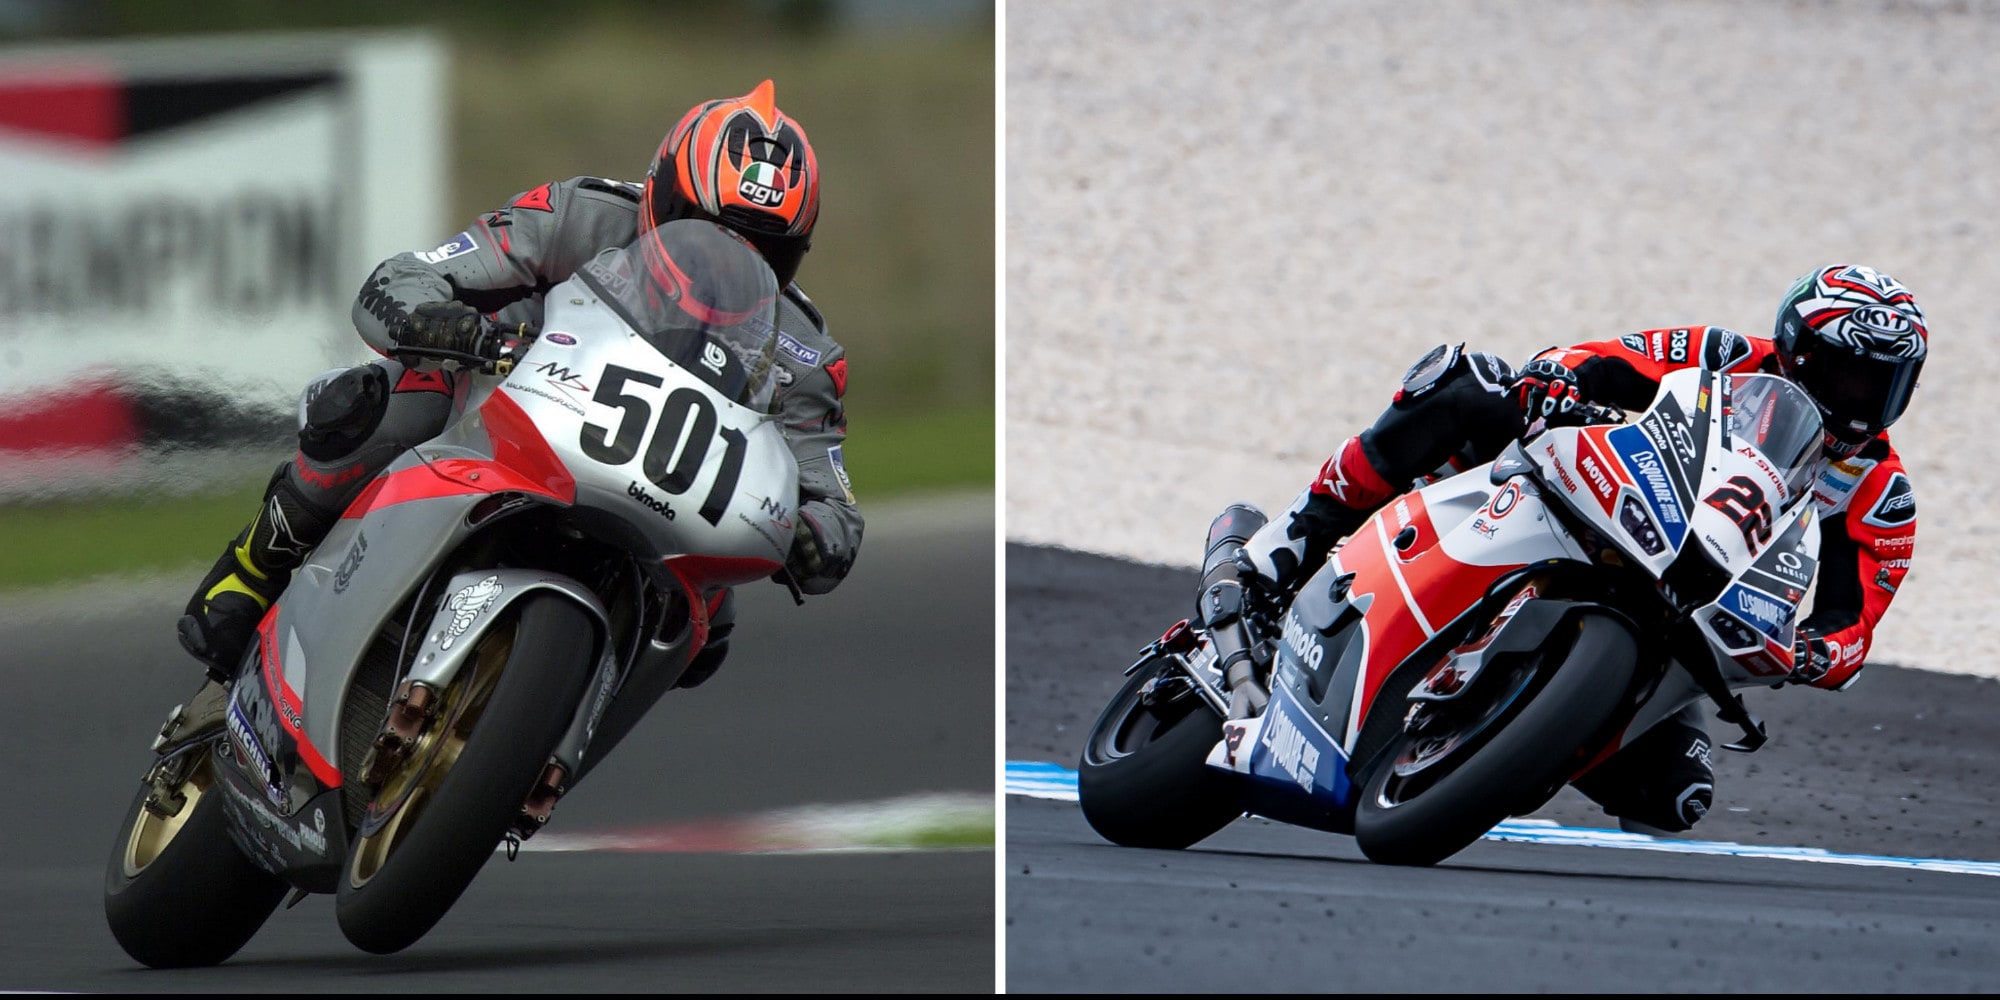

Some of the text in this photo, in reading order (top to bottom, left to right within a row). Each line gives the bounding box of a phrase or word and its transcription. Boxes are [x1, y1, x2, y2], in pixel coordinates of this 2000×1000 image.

[739, 181, 785, 205] agv
[1855, 308, 1906, 330] KYT
[579, 363, 748, 528] 501
[1645, 418, 1668, 450] bimota
[1662, 412, 1690, 465] OAKLEY
[1553, 457, 1577, 494] SHOWA
[1581, 456, 1613, 498] MOTUL
[617, 480, 676, 522] bimota
[1703, 475, 1772, 558] 22
[1706, 535, 1729, 563] bimota
[1880, 559, 1909, 568] MOTU
[1775, 564, 1808, 583] OAKLEY
[1285, 607, 1324, 671] bimota
[229, 710, 278, 794] MICHELI
